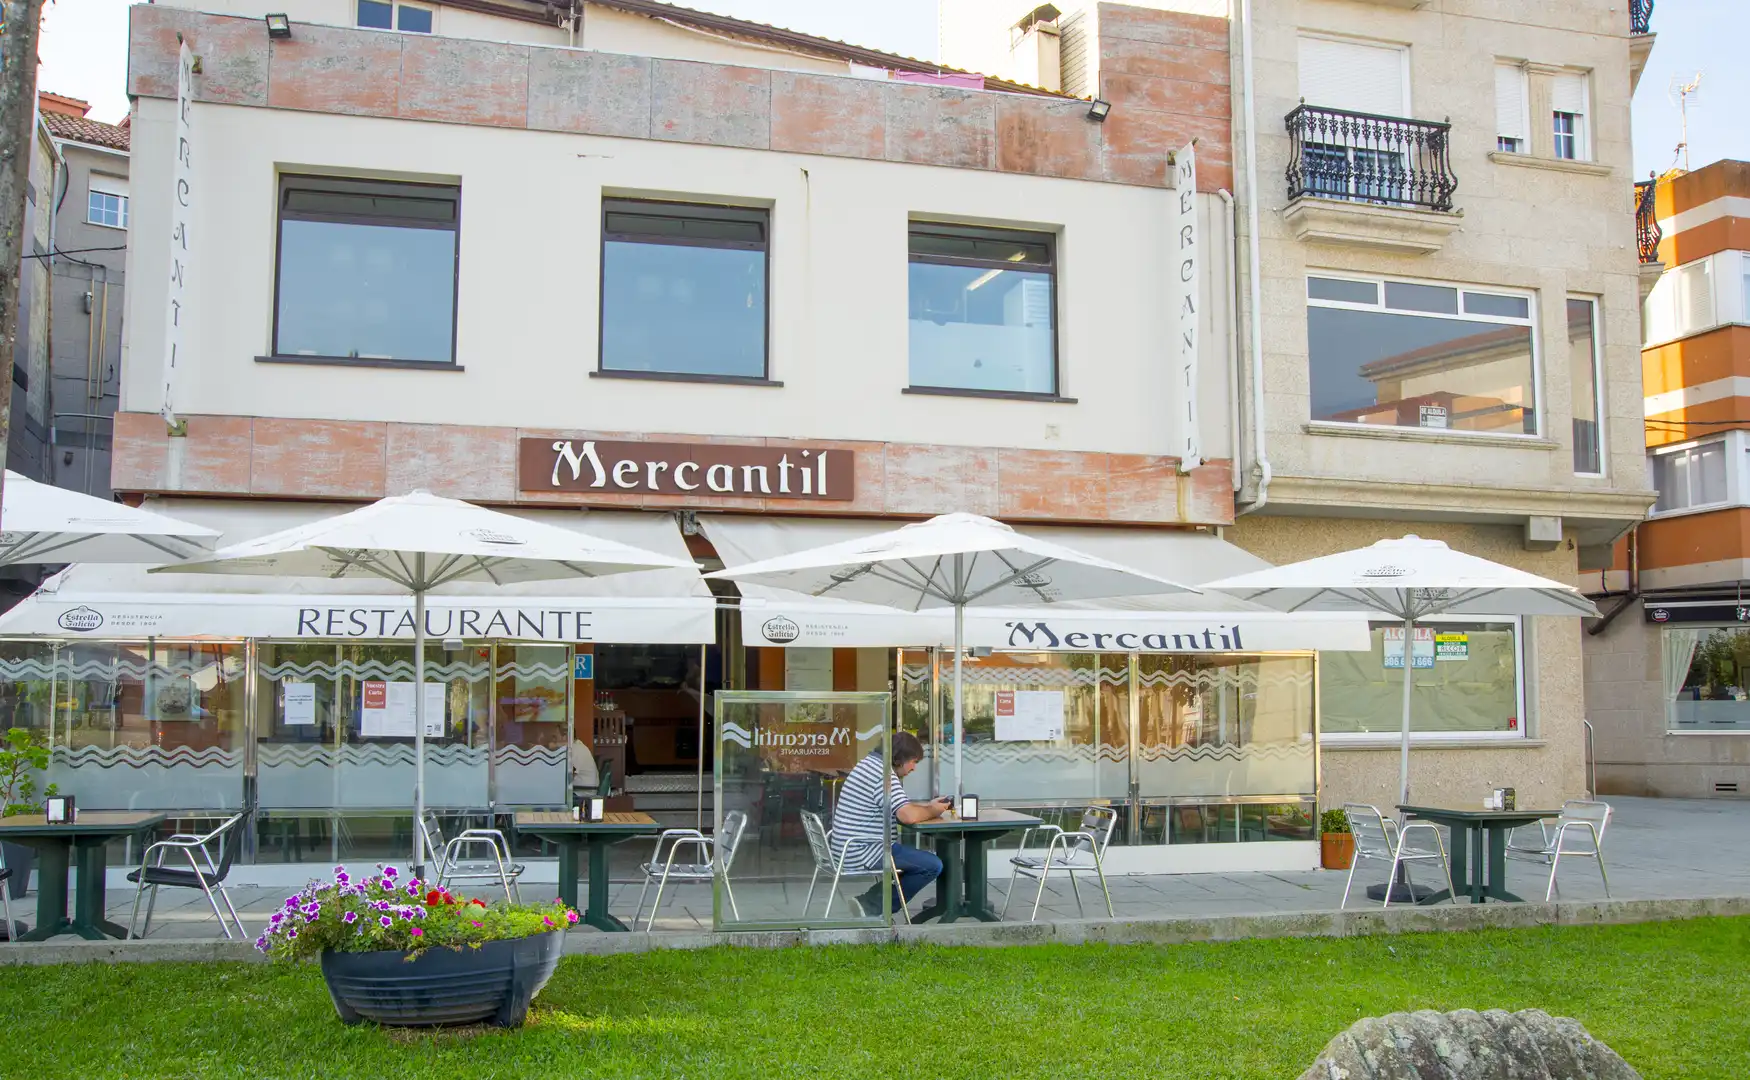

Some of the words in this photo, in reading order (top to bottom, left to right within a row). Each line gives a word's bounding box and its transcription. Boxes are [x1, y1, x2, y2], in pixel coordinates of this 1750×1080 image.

[1178, 160, 1198, 458] MERCANTIL
[551, 441, 828, 495] Mercantil
[65, 613, 98, 621] Estrella
[65, 620, 95, 628] Galicia
[297, 608, 593, 640] RESTAURANTE
[767, 623, 795, 631] Estrella
[768, 630, 794, 638] Galicia
[1005, 622, 1243, 650] Mercantil
[575, 656, 586, 670] R
